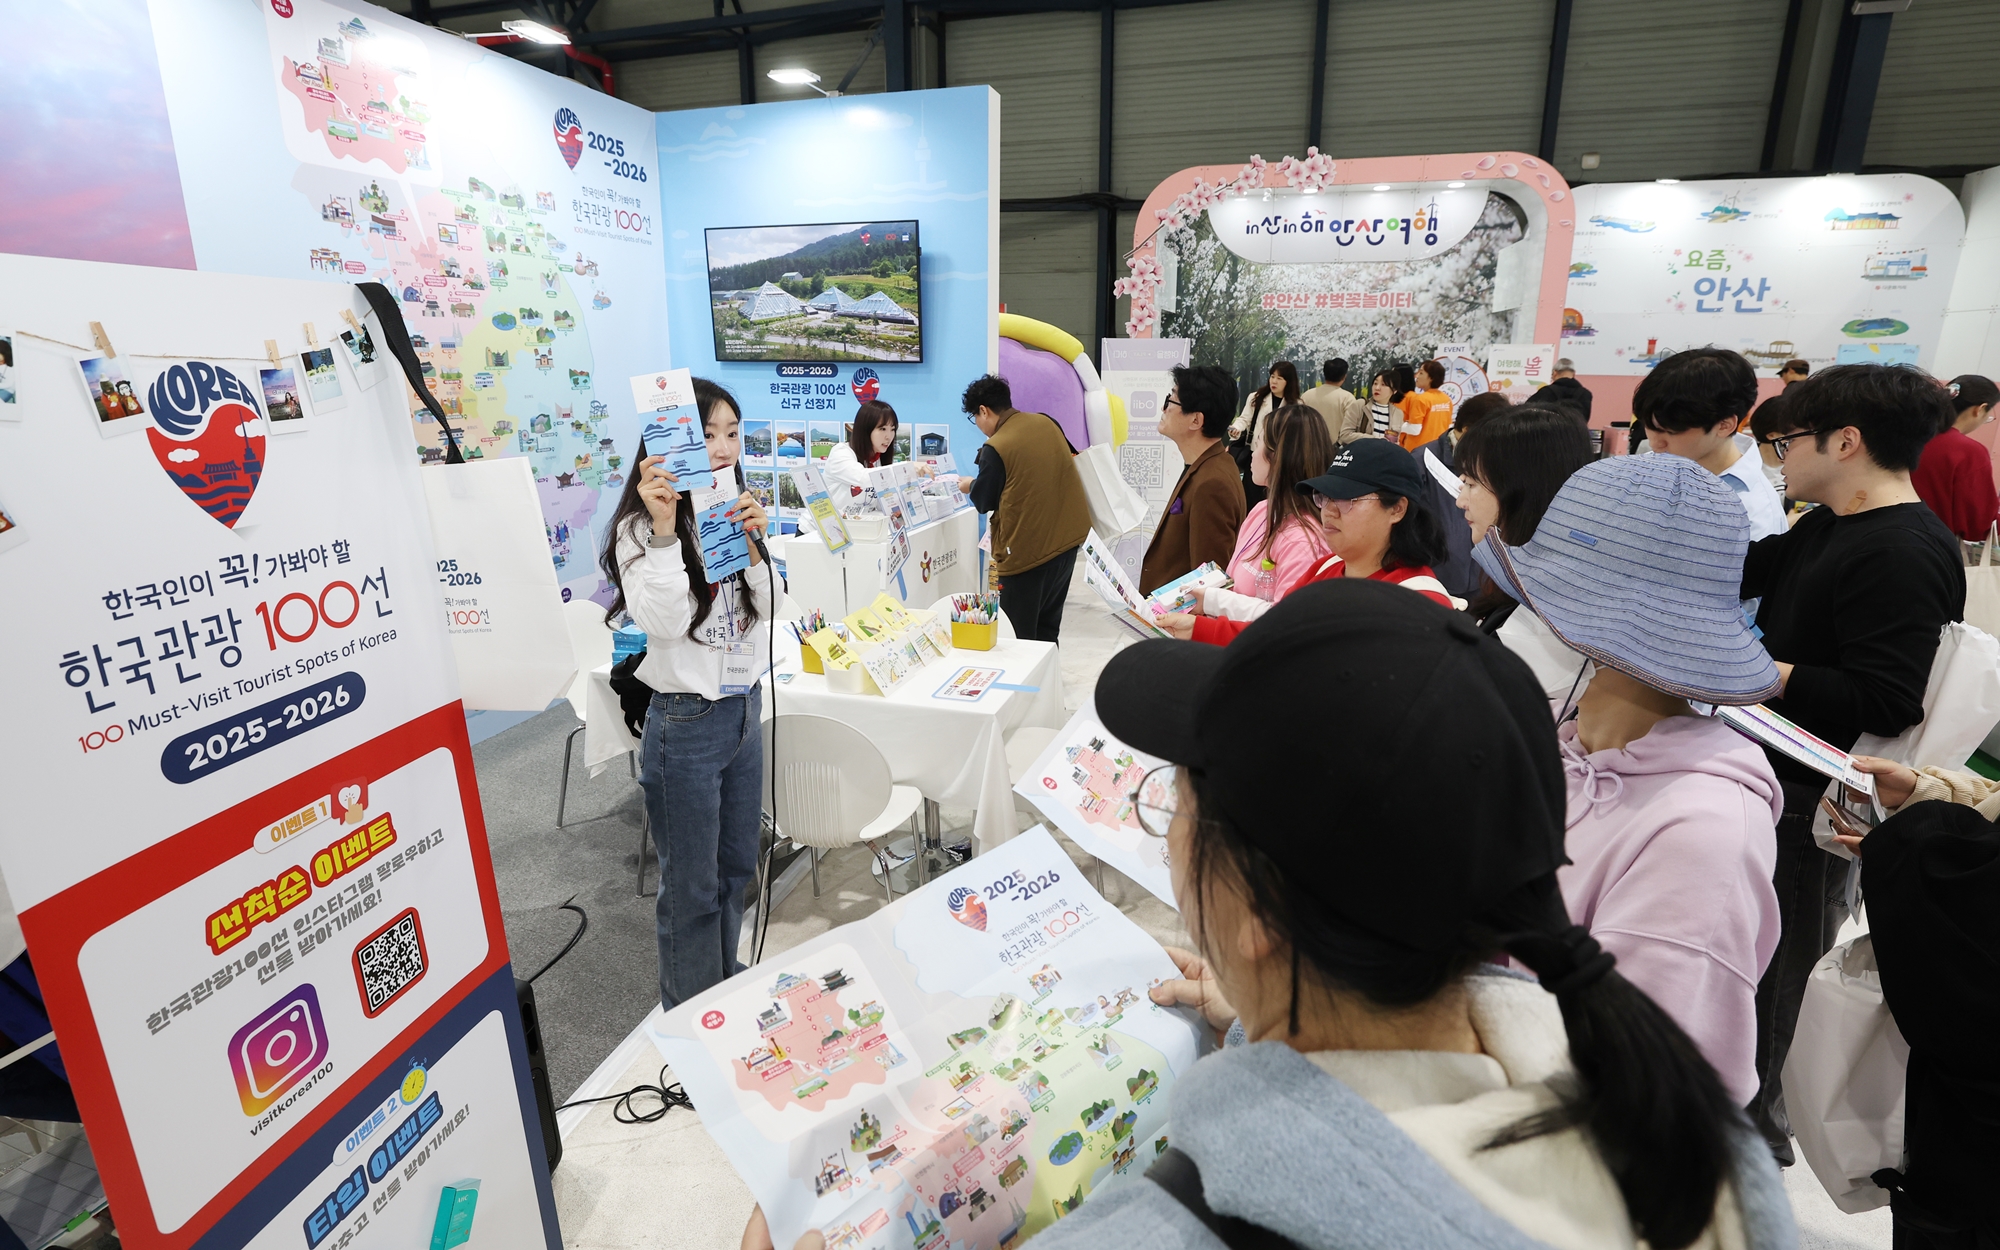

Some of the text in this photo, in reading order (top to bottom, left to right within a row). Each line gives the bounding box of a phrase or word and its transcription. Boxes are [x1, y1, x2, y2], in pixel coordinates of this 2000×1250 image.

[587, 131, 625, 157] 2025
[604, 159, 648, 182] -2026
[582, 186, 606, 200] 한국인이
[607, 189, 617, 203] 꼭!
[618, 194, 635, 207] 가봐야
[572, 199, 652, 236] 한국관광 100선
[584, 228, 608, 239] Must-Visit
[608, 231, 622, 241] Tourist
[1329, 205, 1438, 246] 안산여행
[1684, 249, 1732, 272] 요즘,
[1262, 292, 1412, 309] #안산 #벚꽃놀이터
[1693, 277, 1771, 313] 안산
[781, 366, 833, 375] 2025-2026
[853, 367, 880, 386] KOREA
[1524, 356, 1543, 376] 봄
[148, 360, 263, 436] KOREA
[770, 383, 846, 395] 한국관광 100선
[781, 398, 836, 410] 신규 선정지
[102, 539, 352, 621] 한국인이 꼭! 가봐야 할
[439, 572, 482, 587] -2026
[452, 608, 490, 625] 100선
[59, 566, 393, 715] 한국관광 100선
[78, 628, 398, 754] 100 Must-Visit Tourist Spots of Korea
[184, 684, 351, 772] 2025-2026
[270, 800, 328, 843] 이벤트 1
[208, 815, 396, 951] 선착순 이벤트
[947, 886, 979, 912] KOREA
[983, 868, 1027, 901] 2025
[1011, 869, 1061, 902] -2026
[145, 828, 445, 1036] 한국관광100선 인스타그램 팔로우하고
[257, 888, 384, 986] 선물 받아가세요!
[998, 902, 1093, 967] 한국관광 100선
[1001, 921, 1030, 942] 한국인이
[1026, 912, 1041, 926] 꼭!
[1040, 902, 1061, 918] 가봐야
[249, 1060, 334, 1137] visitkorea100
[345, 1097, 398, 1154] 이벤트 2
[307, 1096, 443, 1245] 타임 이벤트
[373, 1176, 401, 1215] 선물
[403, 1103, 471, 1182] 받아가세요!
